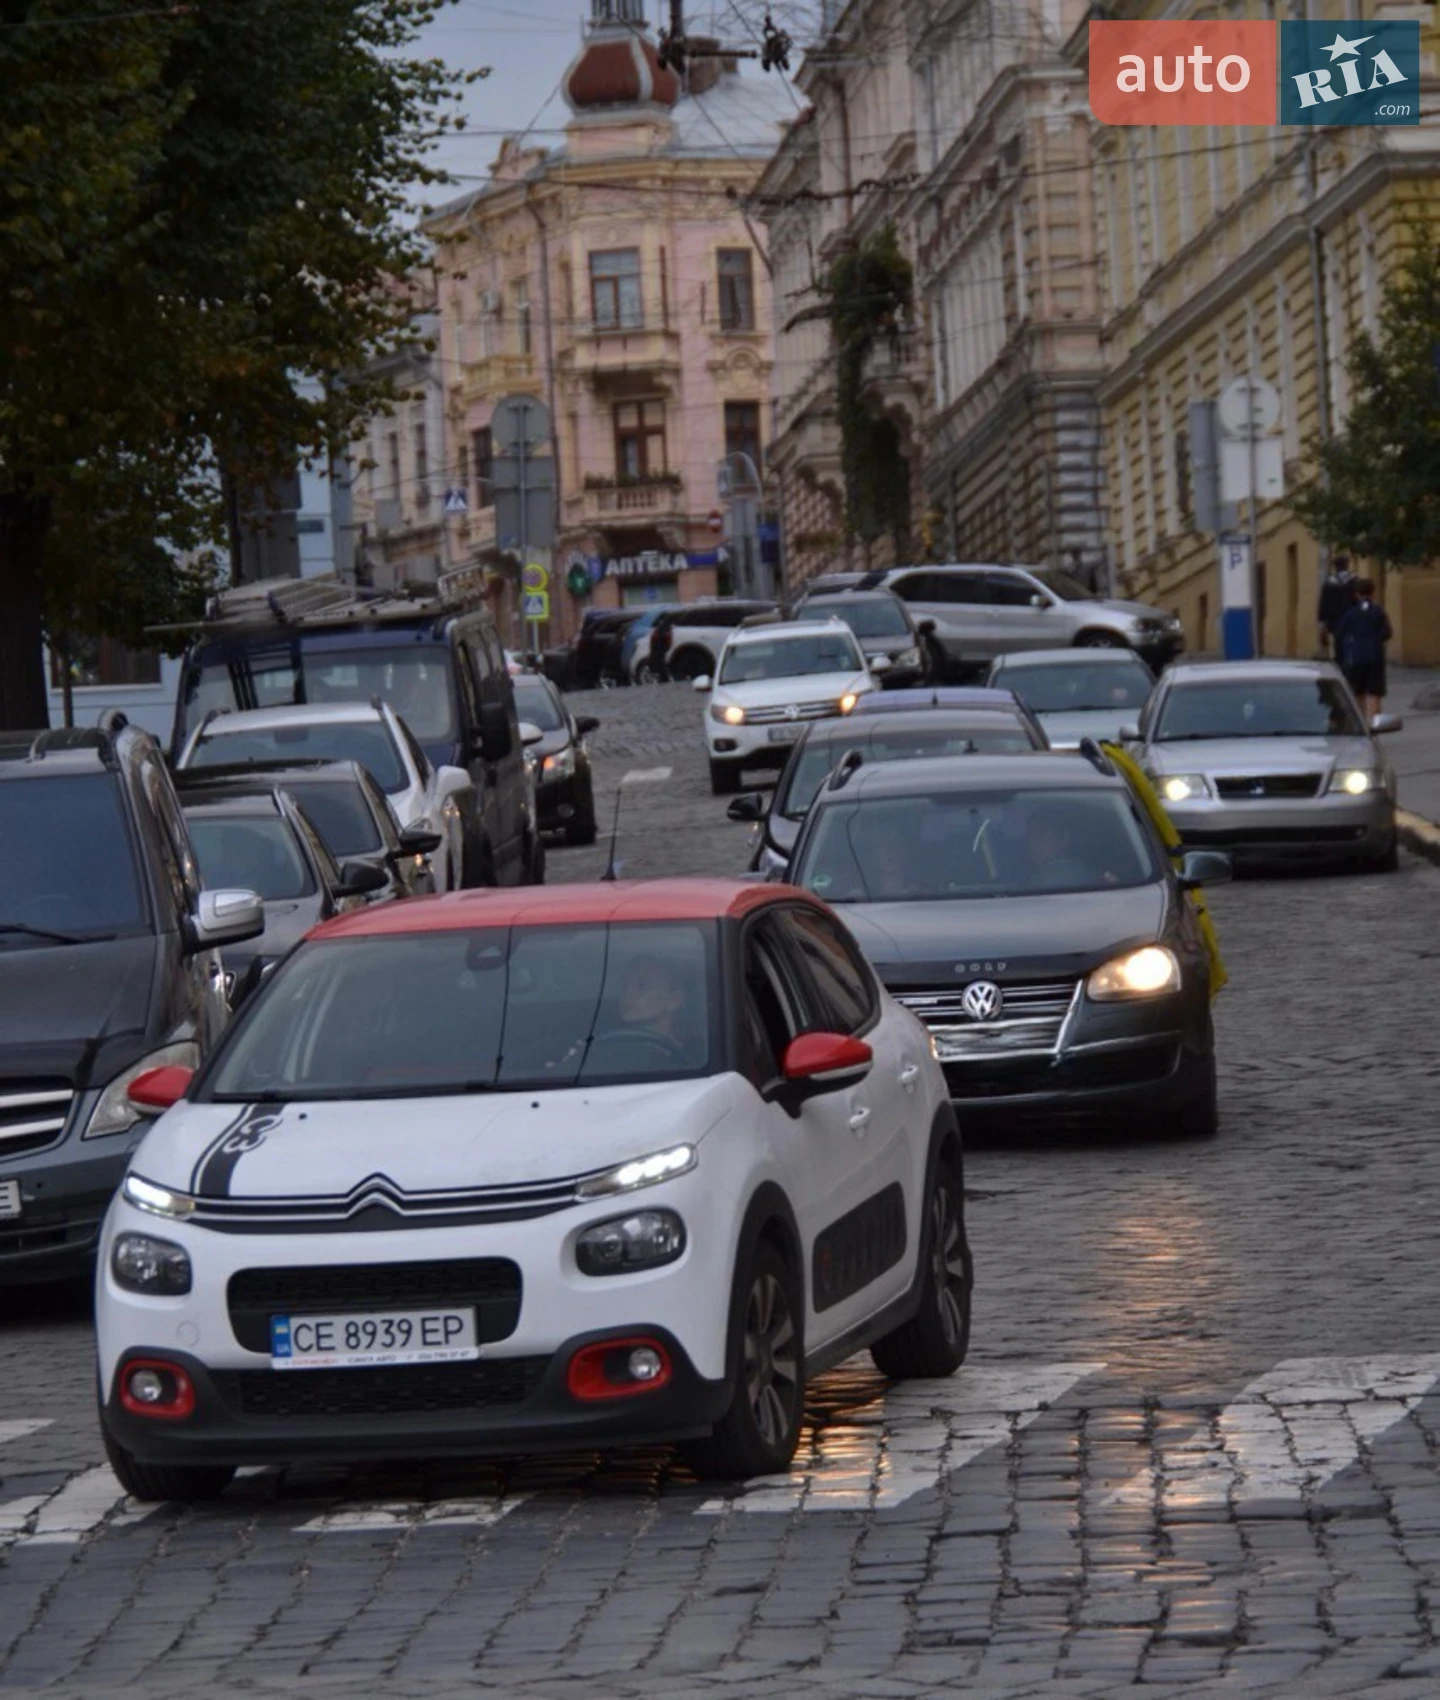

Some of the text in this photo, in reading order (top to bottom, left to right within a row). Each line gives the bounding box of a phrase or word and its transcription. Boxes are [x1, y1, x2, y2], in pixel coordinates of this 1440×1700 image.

[606, 552, 688, 575] АПТЕКА
[293, 1315, 464, 1352] CE 8939 EP
